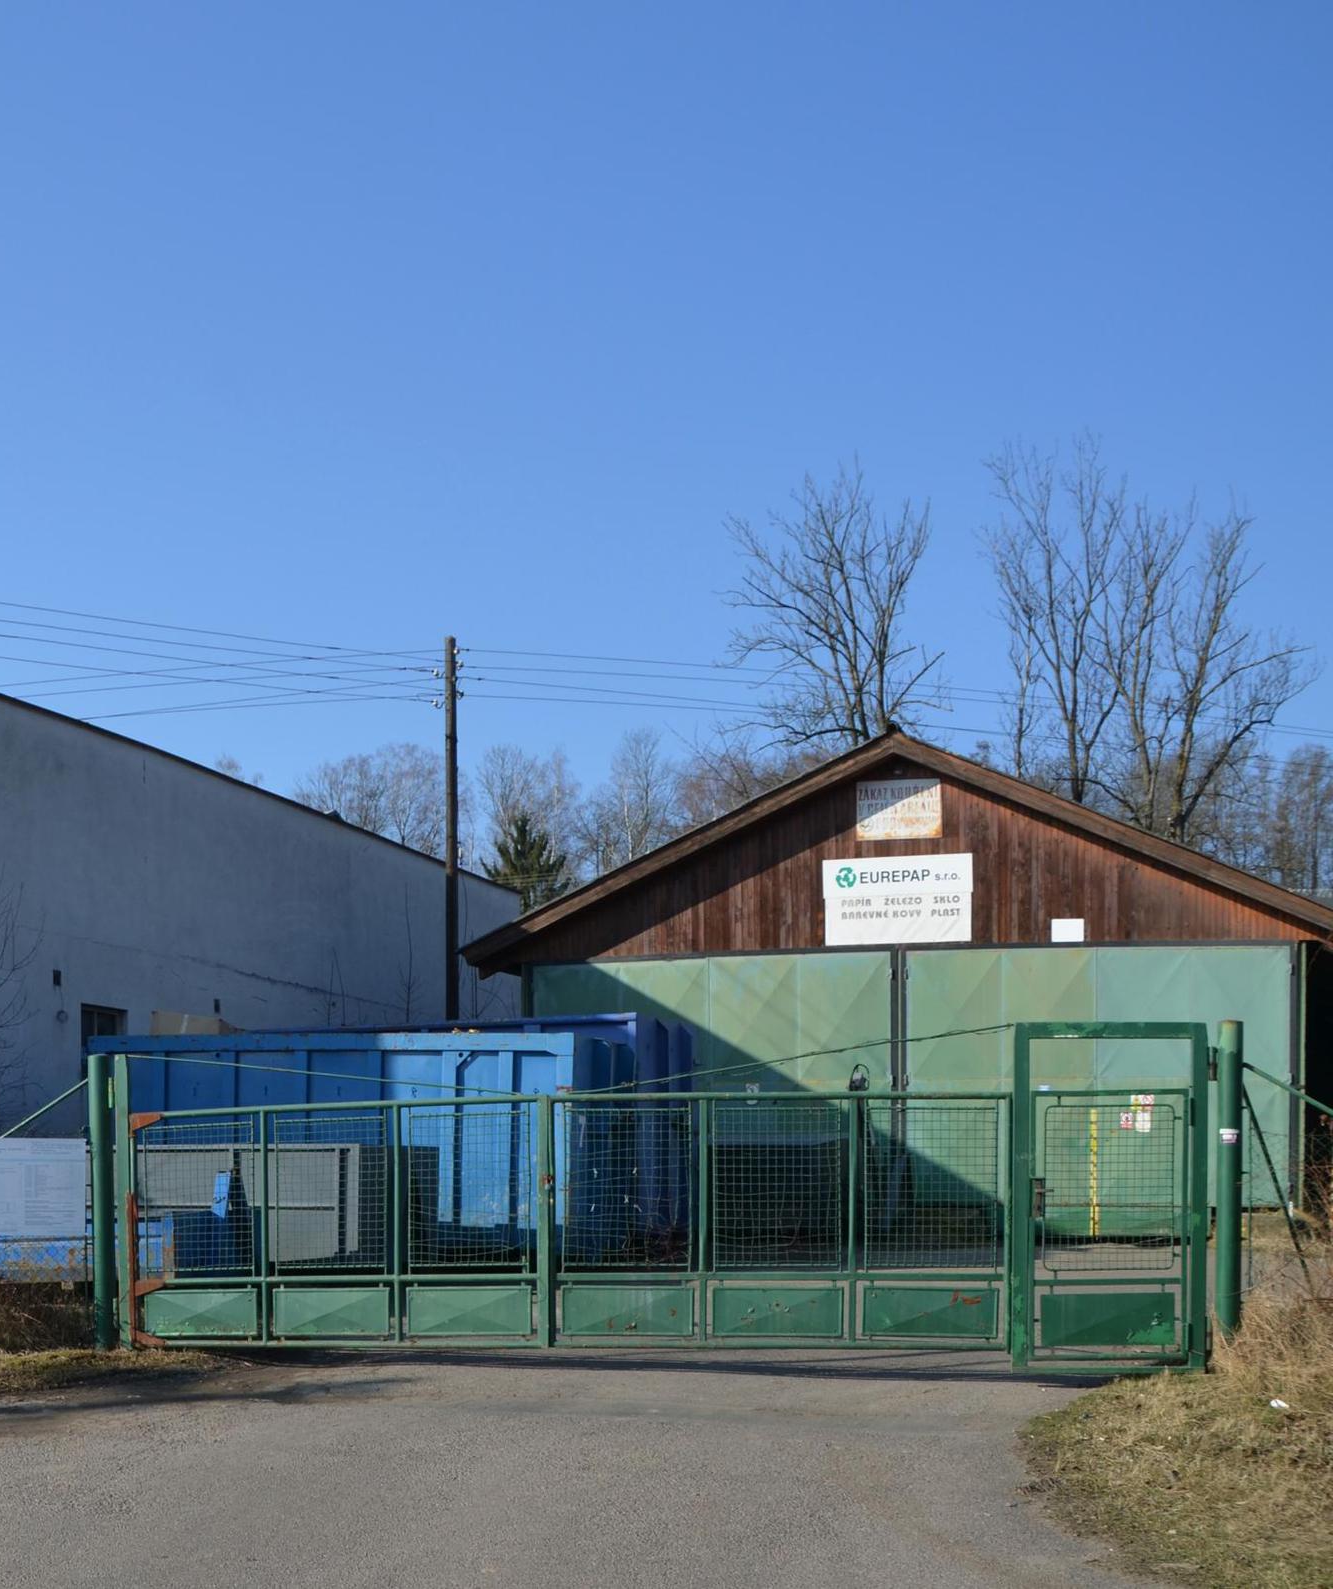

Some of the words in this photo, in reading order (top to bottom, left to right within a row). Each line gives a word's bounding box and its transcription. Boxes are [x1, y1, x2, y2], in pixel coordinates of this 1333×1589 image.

[859, 869, 931, 884] EUREPAP
[934, 872, 961, 881] s.r.o.
[841, 897, 872, 907] PAPÍR
[884, 896, 923, 906] ŽELEZO
[933, 895, 961, 904] SKLO
[841, 909, 889, 920] BAREVNÉ
[893, 909, 922, 918] KOVY
[931, 908, 961, 917] PLAST
